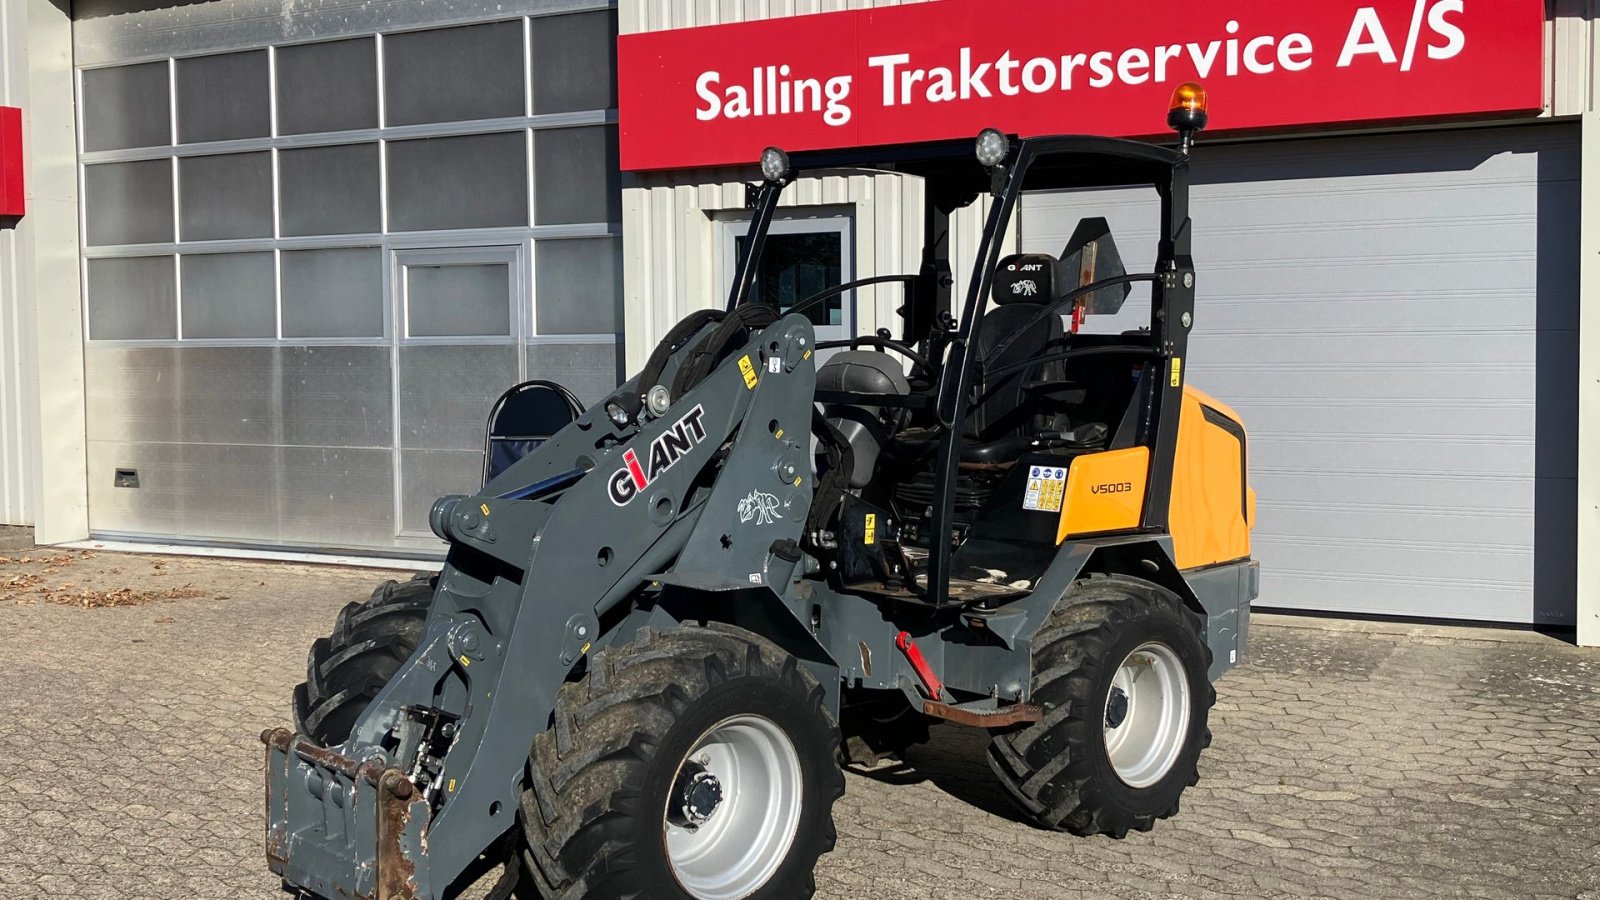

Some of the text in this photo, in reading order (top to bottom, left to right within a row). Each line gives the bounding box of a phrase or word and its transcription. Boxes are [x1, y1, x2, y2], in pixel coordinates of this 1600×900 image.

[695, 0, 1466, 127] Salling Traktorservice A/S
